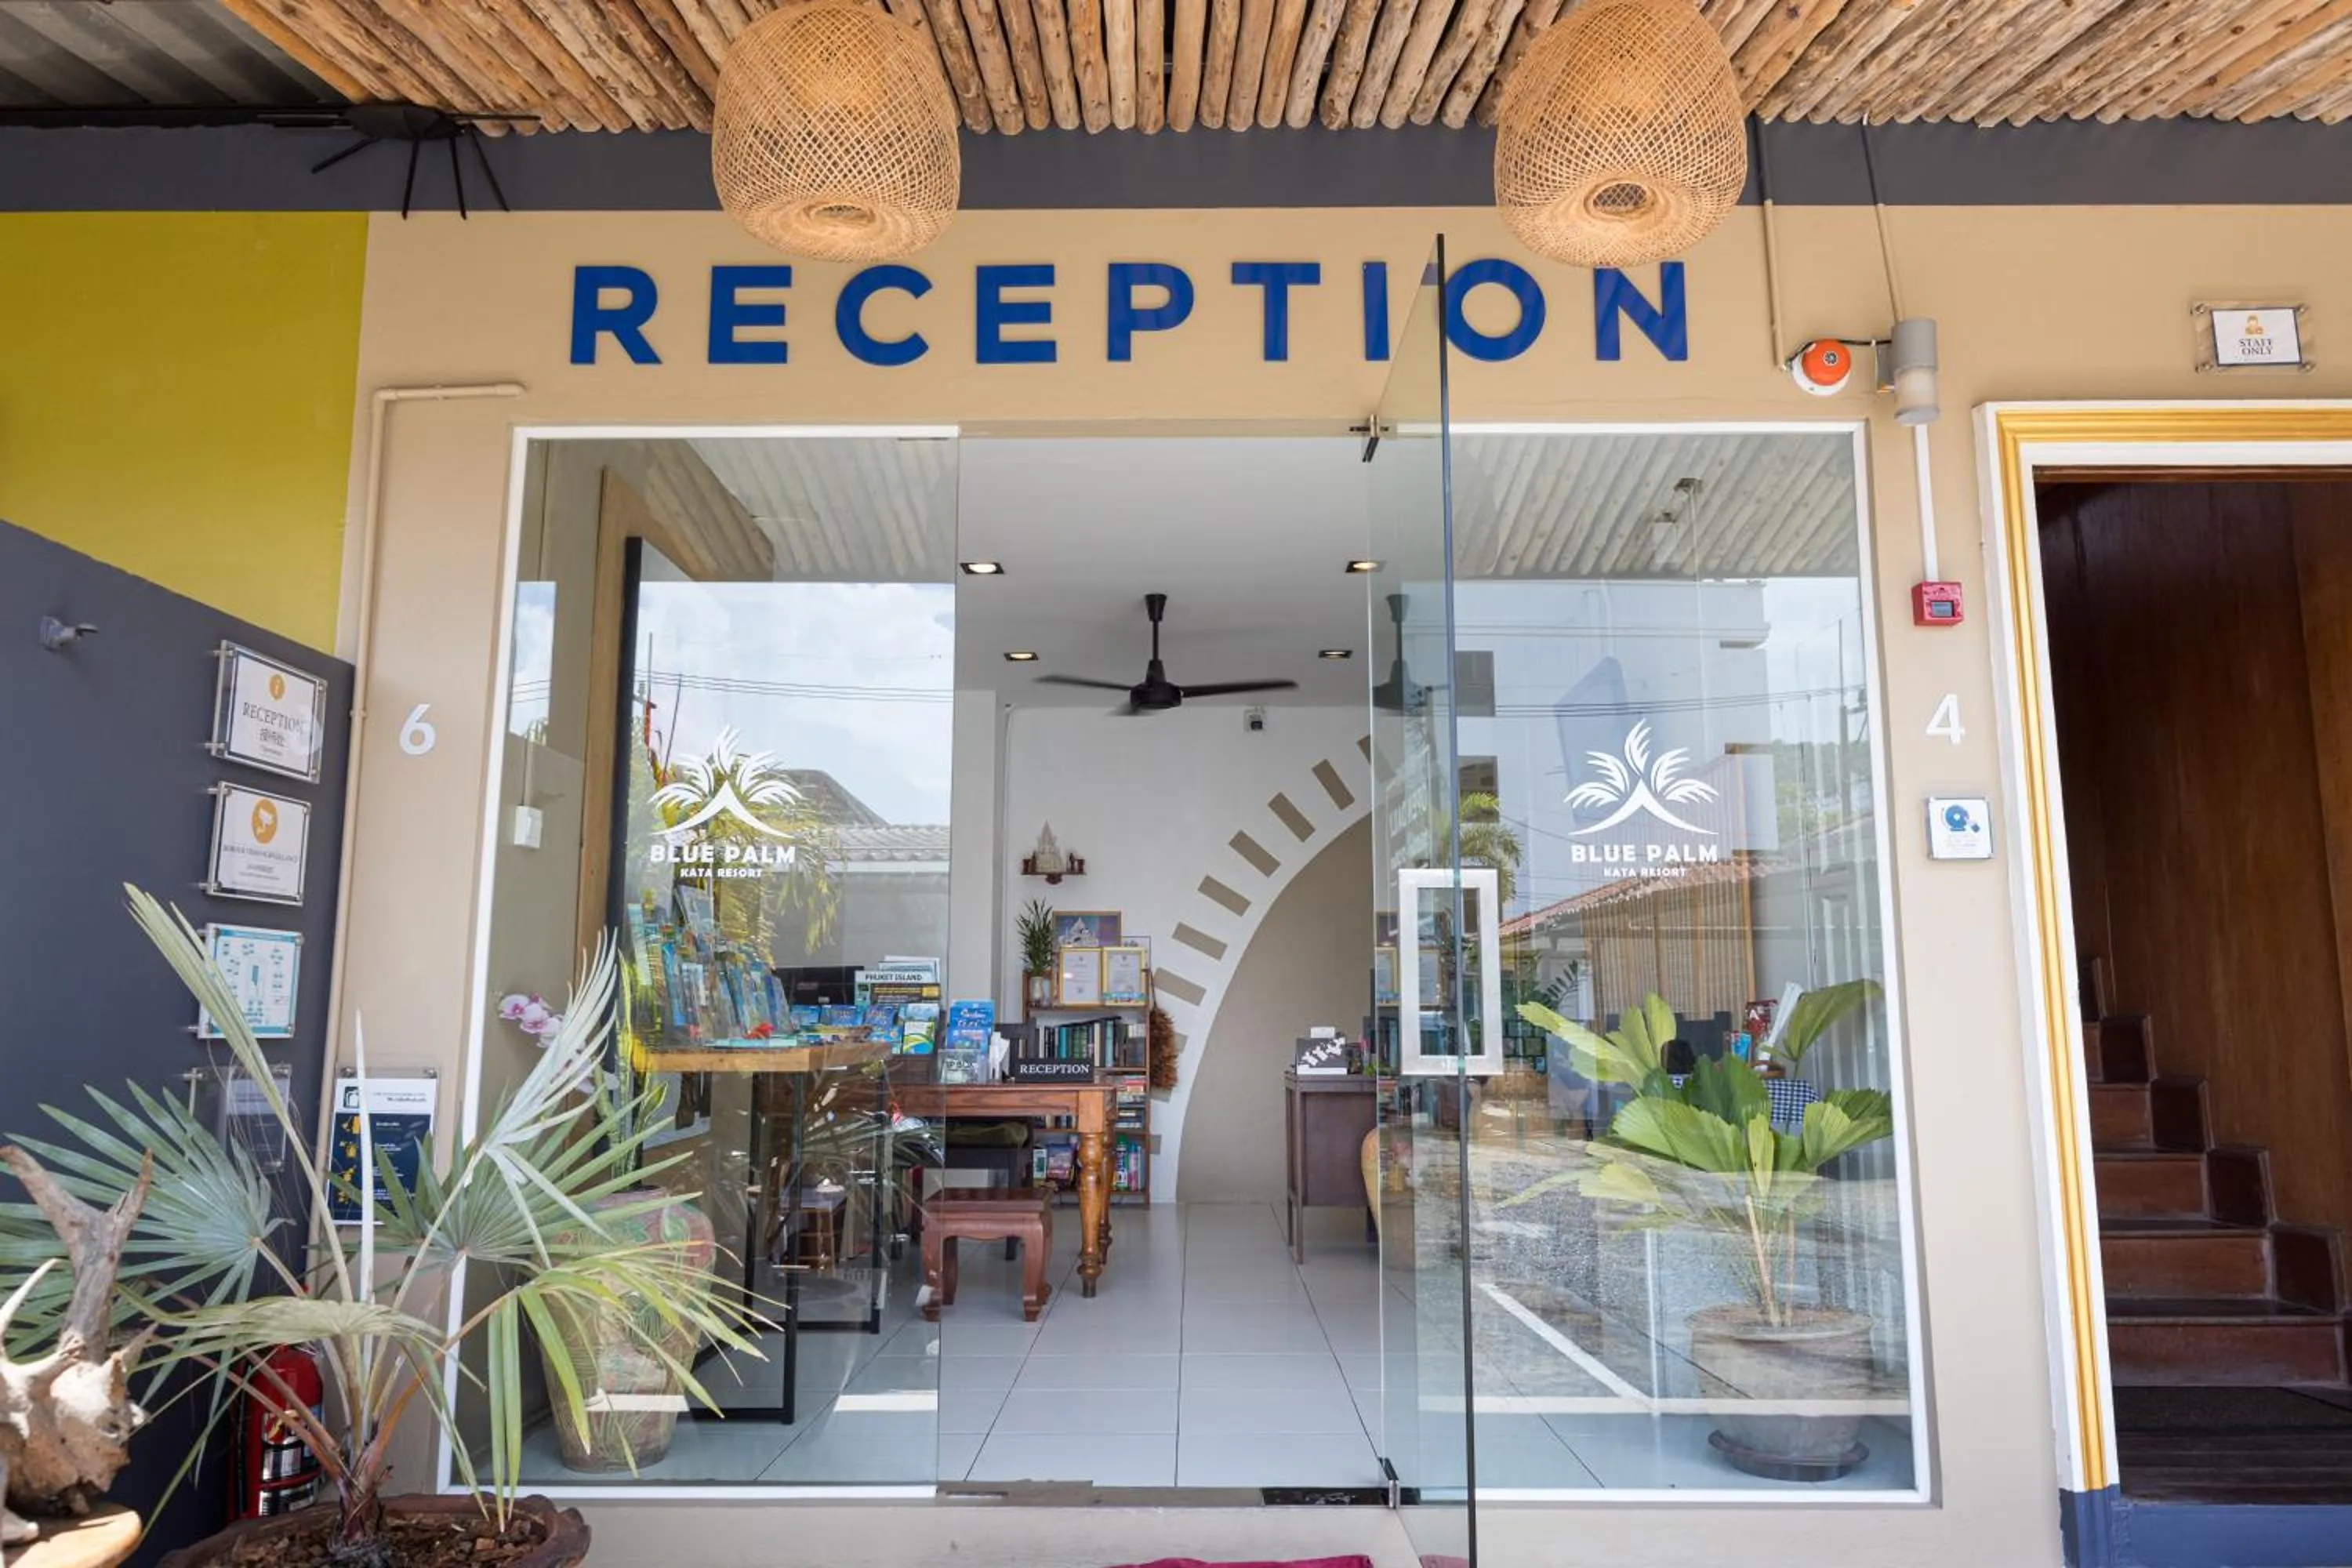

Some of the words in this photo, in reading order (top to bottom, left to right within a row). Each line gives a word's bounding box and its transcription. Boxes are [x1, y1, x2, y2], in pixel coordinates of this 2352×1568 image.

[569, 258, 1688, 366] RECEPTION
[2239, 339, 2273, 347] STAFF
[242, 702, 304, 735] RECEPTION
[1926, 693, 1965, 746] 4
[399, 703, 435, 755] 6
[650, 844, 714, 863] BLUE
[724, 844, 796, 863] PALM
[1570, 844, 1636, 862] BLUE
[1646, 844, 1718, 862] PALM
[680, 868, 712, 877] KATA
[717, 868, 763, 877] RESORT
[1603, 867, 1636, 877] KATA
[1641, 867, 1687, 877] RESORT
[1019, 1063, 1091, 1075] RECEPTION
